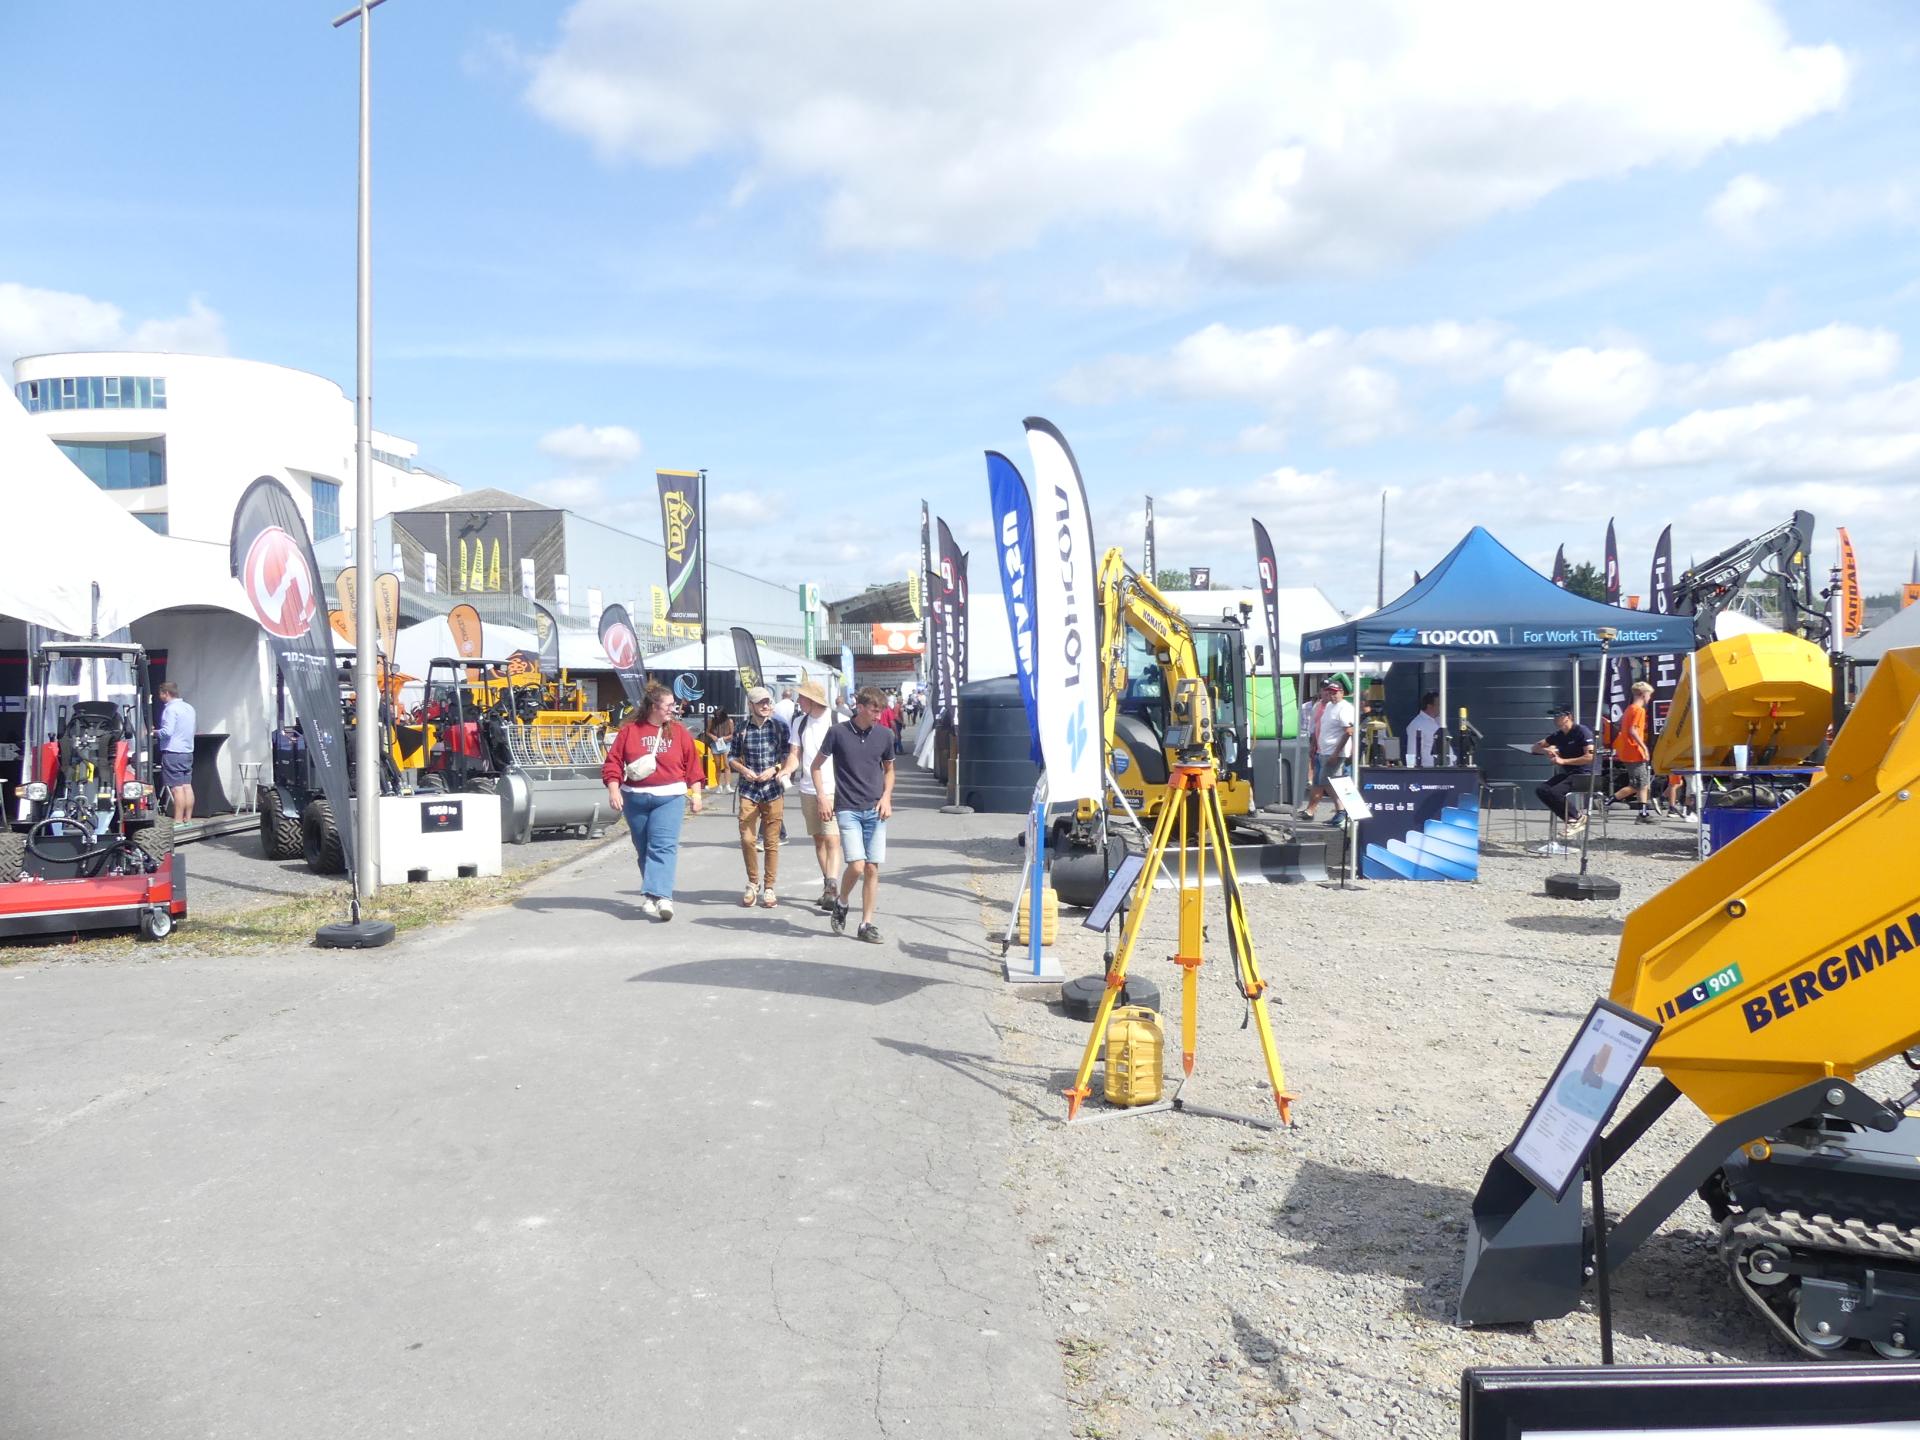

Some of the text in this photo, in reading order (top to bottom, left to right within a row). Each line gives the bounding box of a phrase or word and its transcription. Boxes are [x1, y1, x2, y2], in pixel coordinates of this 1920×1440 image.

[1143, 609, 1167, 637] KOMATSU
[1656, 556, 1677, 688] HICHI
[1417, 630, 1499, 645] TOPCON
[1523, 631, 1542, 642] For
[1545, 630, 1578, 642] Work
[698, 702, 718, 714] Bo
[1693, 968, 1737, 1002] C 901
